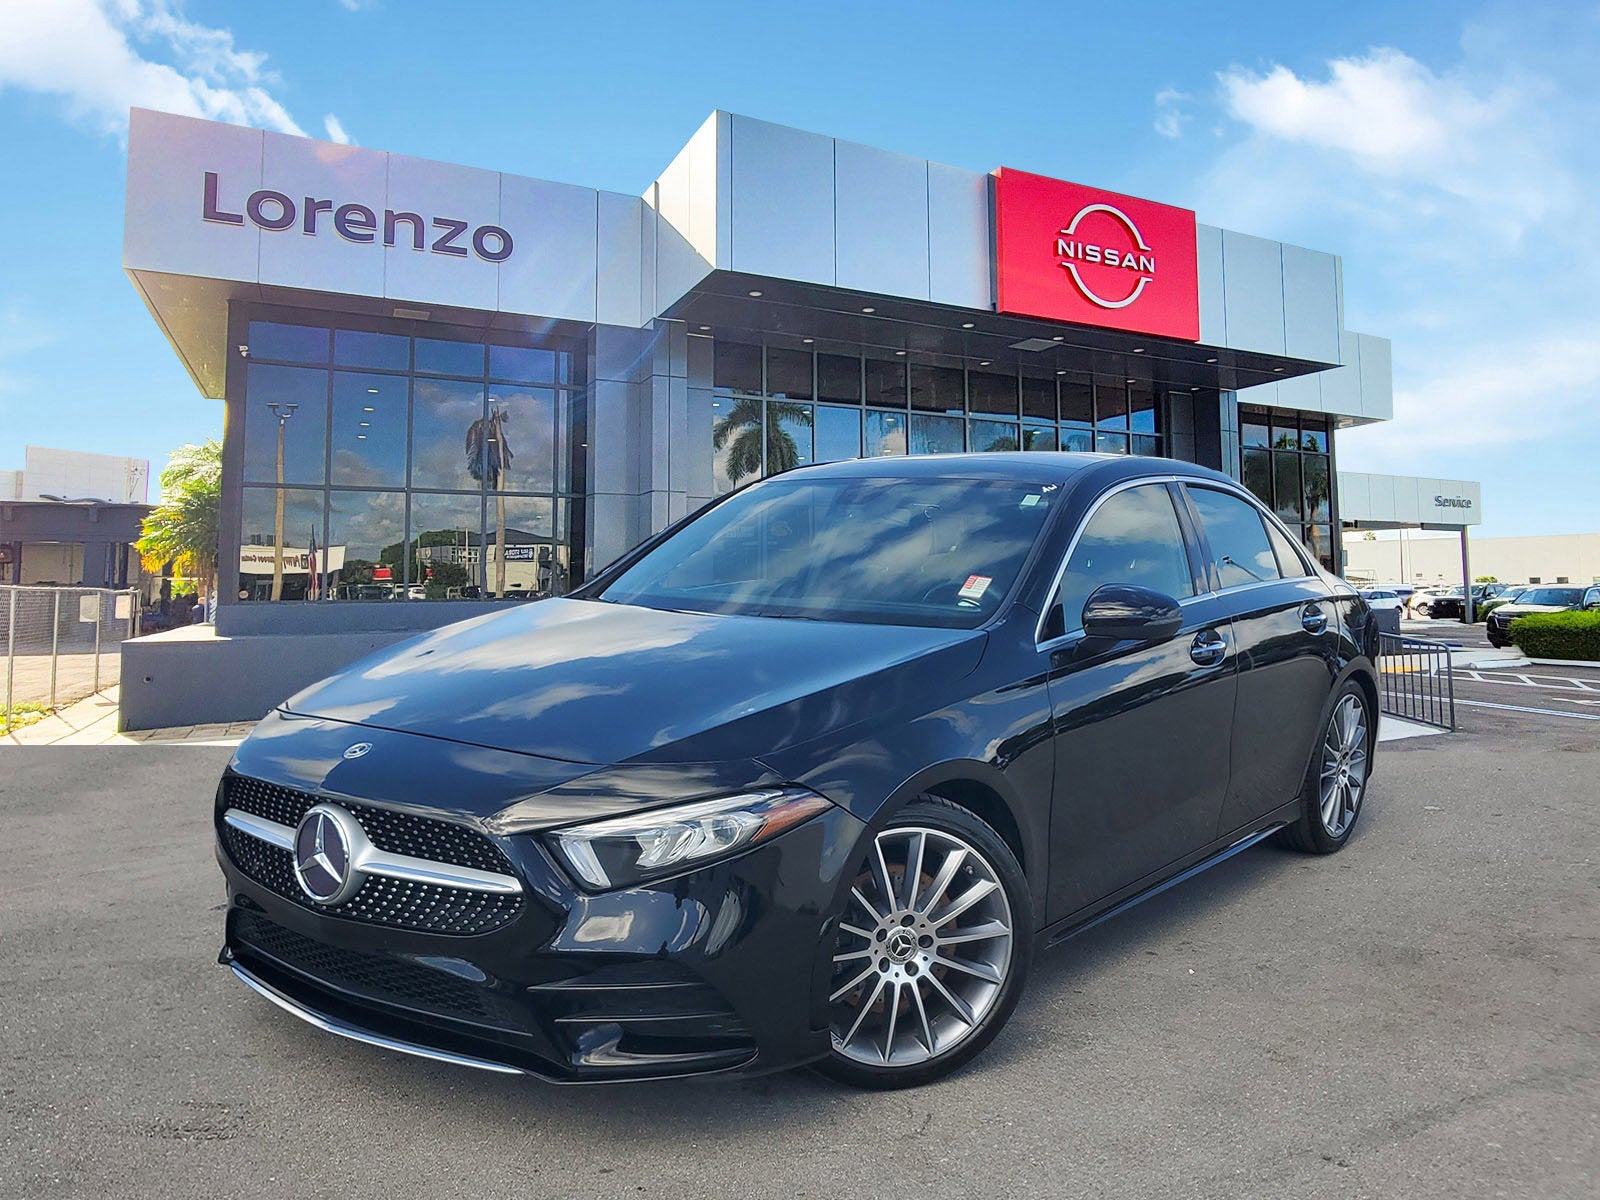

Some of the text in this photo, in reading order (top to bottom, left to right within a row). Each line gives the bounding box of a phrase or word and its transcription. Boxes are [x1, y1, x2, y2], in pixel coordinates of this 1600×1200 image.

[202, 170, 514, 262] Lorenzo
[1057, 238, 1155, 273] NISSAN
[1434, 495, 1472, 508] Service
